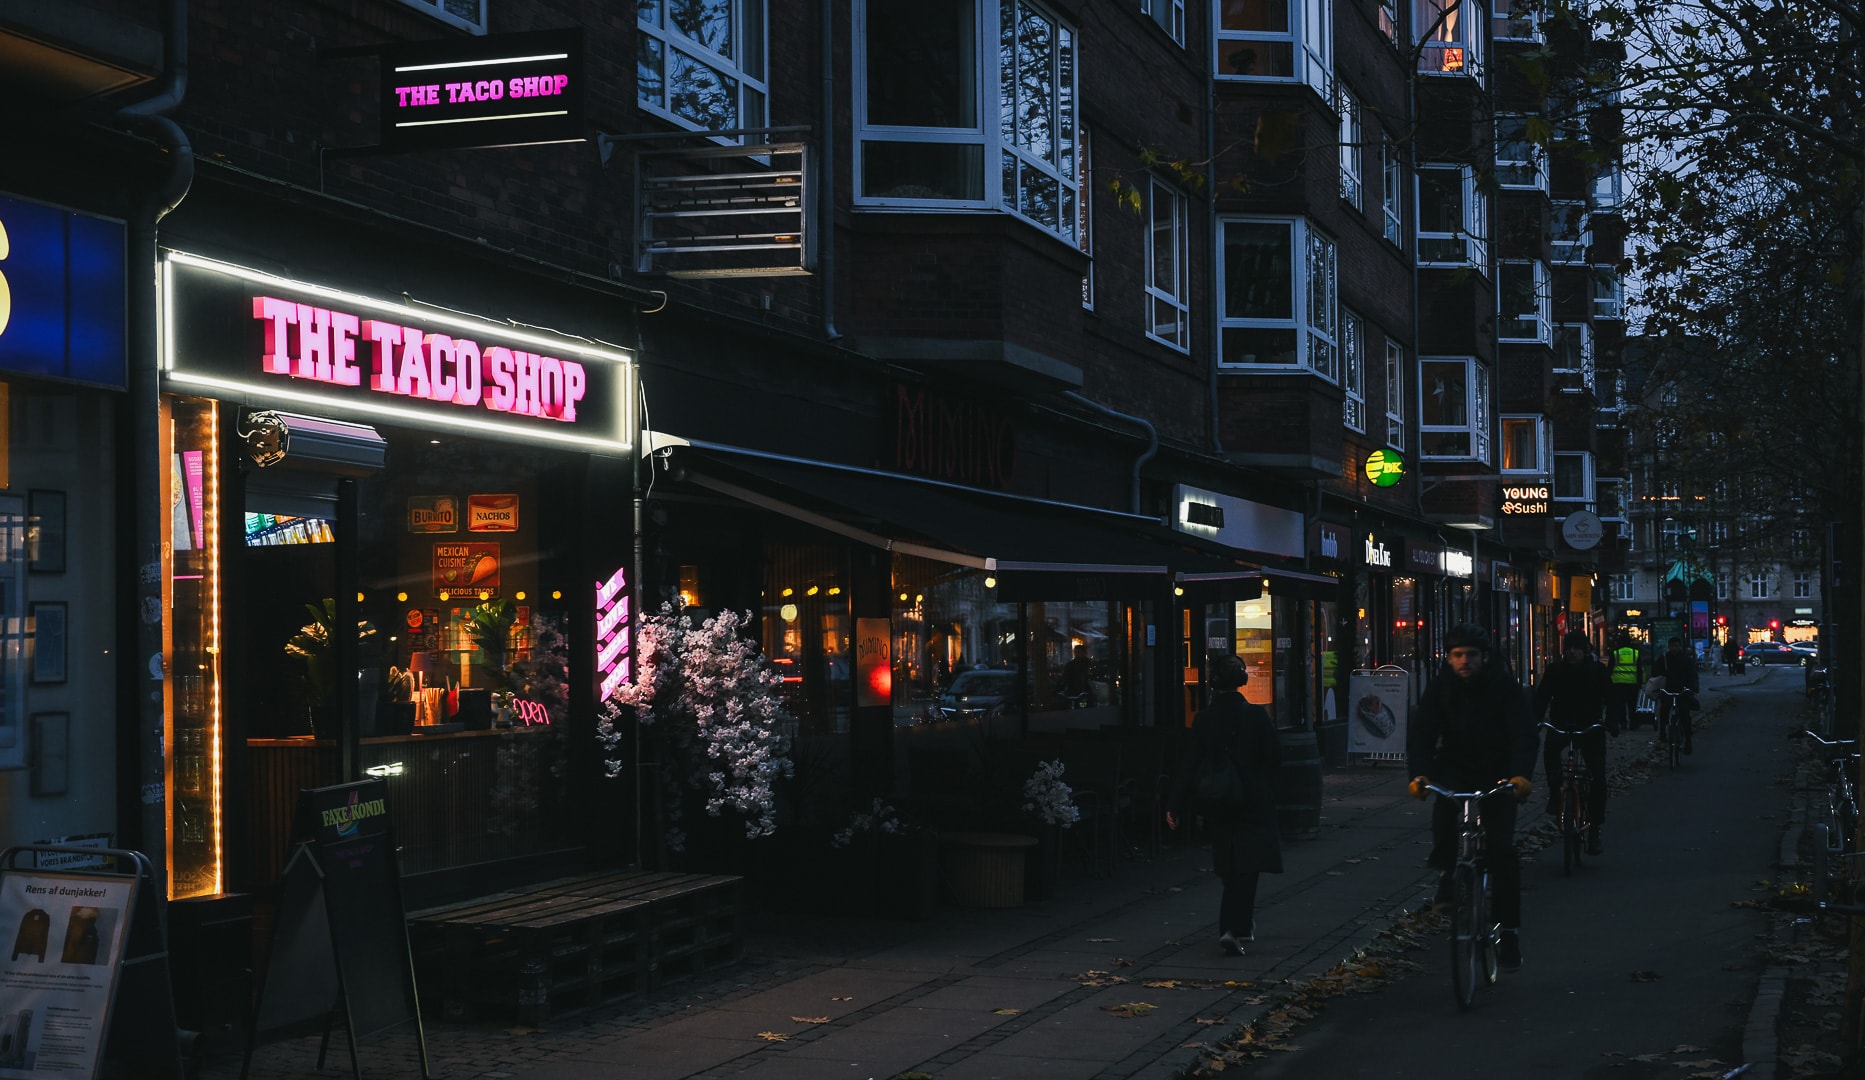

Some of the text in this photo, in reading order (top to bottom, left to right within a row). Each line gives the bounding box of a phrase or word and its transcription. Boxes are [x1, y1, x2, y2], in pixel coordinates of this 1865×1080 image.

[395, 74, 568, 107] THE TACO SHOP
[253, 296, 586, 422] THE TACO SHOP
[1502, 487, 1549, 499] YOUNG
[1514, 501, 1548, 513] Sushi
[413, 510, 452, 523] BURRITO
[475, 512, 511, 521] NACHOS
[437, 546, 469, 557] MEXICAN
[438, 557, 466, 568] CUISINE
[440, 587, 495, 597] DELICIOUS TACOS
[599, 601, 625, 635] LOVE
[321, 798, 386, 827] FAXE KONDI
[25, 885, 107, 898] Rens af dunjakker!
